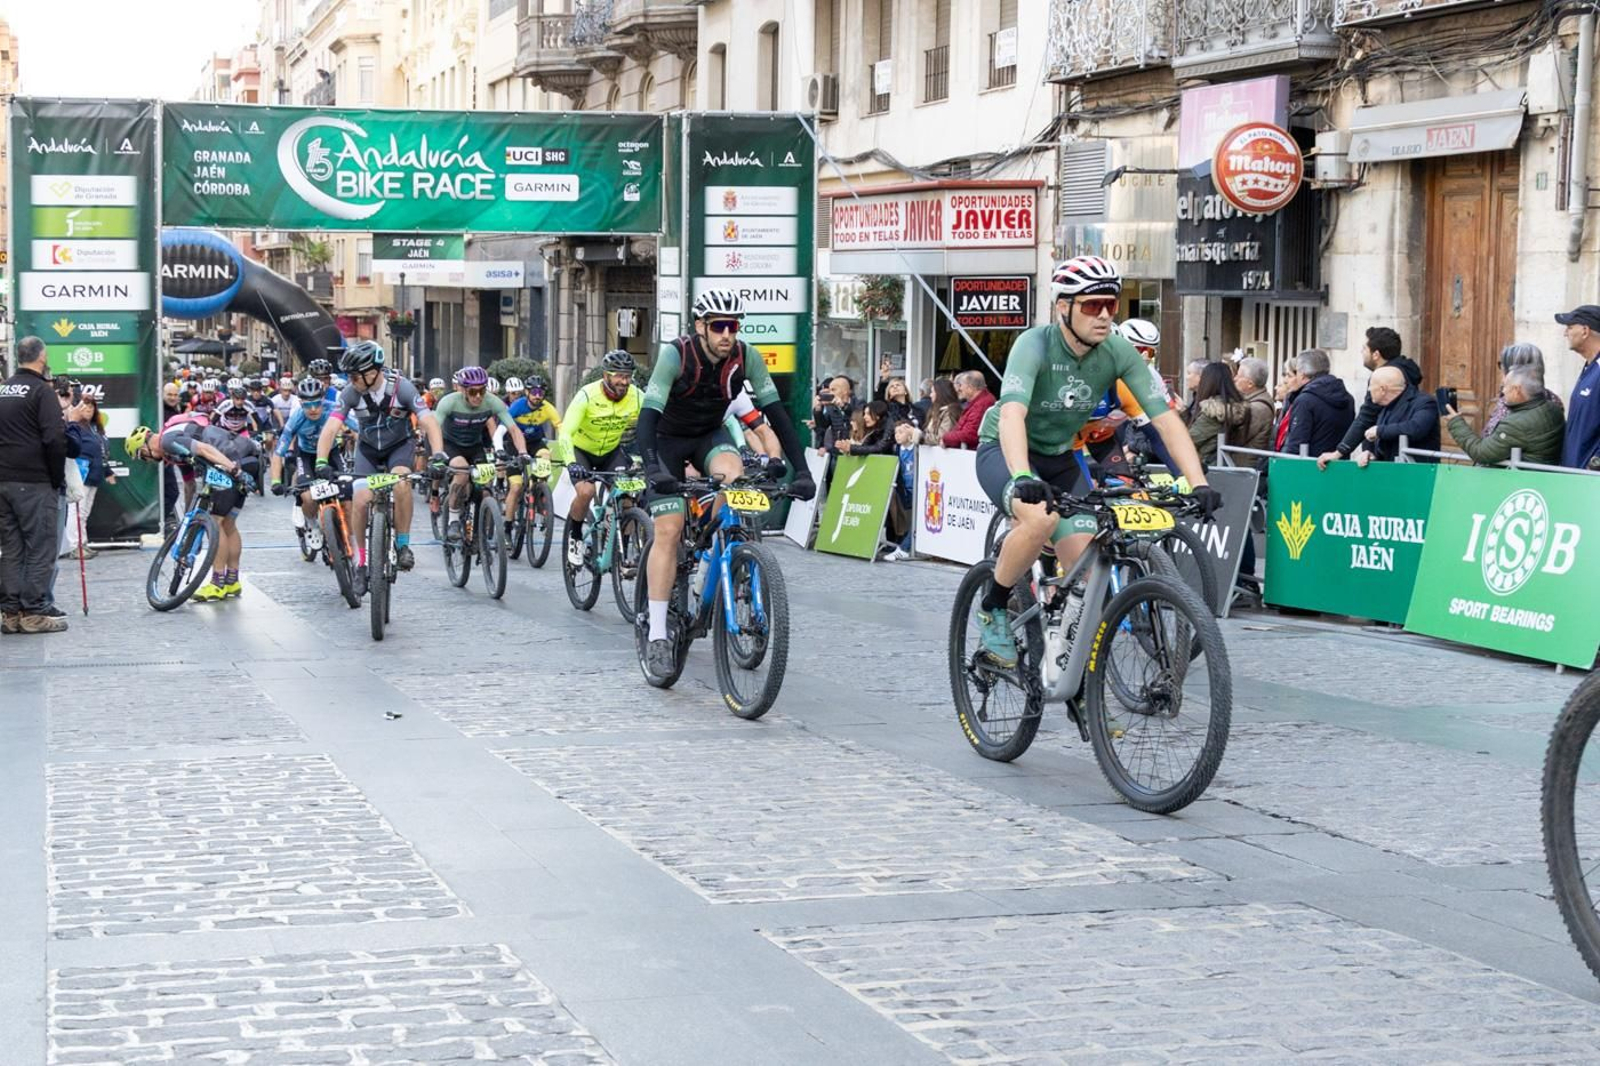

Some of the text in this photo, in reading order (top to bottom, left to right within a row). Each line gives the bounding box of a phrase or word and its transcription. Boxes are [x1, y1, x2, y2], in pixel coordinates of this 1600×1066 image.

[27, 137, 97, 154] Andalucía
[335, 131, 495, 173] Andalucía
[194, 150, 251, 164] GRANADA
[512, 151, 565, 162] UCI SHC
[702, 150, 764, 167] Andalucía
[1228, 154, 1295, 175] Mahou
[194, 163, 225, 179] JAÉN
[194, 180, 250, 195] CÓRDOBA
[336, 171, 496, 200] BIKE RACE
[513, 182, 571, 192] GARMIN
[950, 195, 1032, 208] OPORTUNIDADES
[834, 199, 942, 242] OPORTUNIDADES JAVIER
[952, 209, 1031, 230] JAVIER
[392, 238, 445, 247] STAGE 4
[834, 230, 899, 243] TODO EN TELAS
[951, 230, 1032, 240] TODO EN TELAS
[408, 248, 429, 258] JAÉN
[161, 264, 229, 279] ARMIN
[954, 280, 1027, 291] OPORTUNIDADES
[1241, 270, 1271, 290] 1974
[41, 284, 129, 298] GARMIN
[959, 295, 1021, 311] JAVIER
[957, 316, 1024, 326] TODO EN TELAS
[729, 491, 766, 506] 235-2
[947, 514, 976, 531] DE JAÉN
[1119, 506, 1167, 524] 235-1
[1322, 512, 1425, 544] CAJA RURAL
[1350, 542, 1394, 571] JAÉN
[1449, 598, 1555, 632] SPORT BEARINGS
